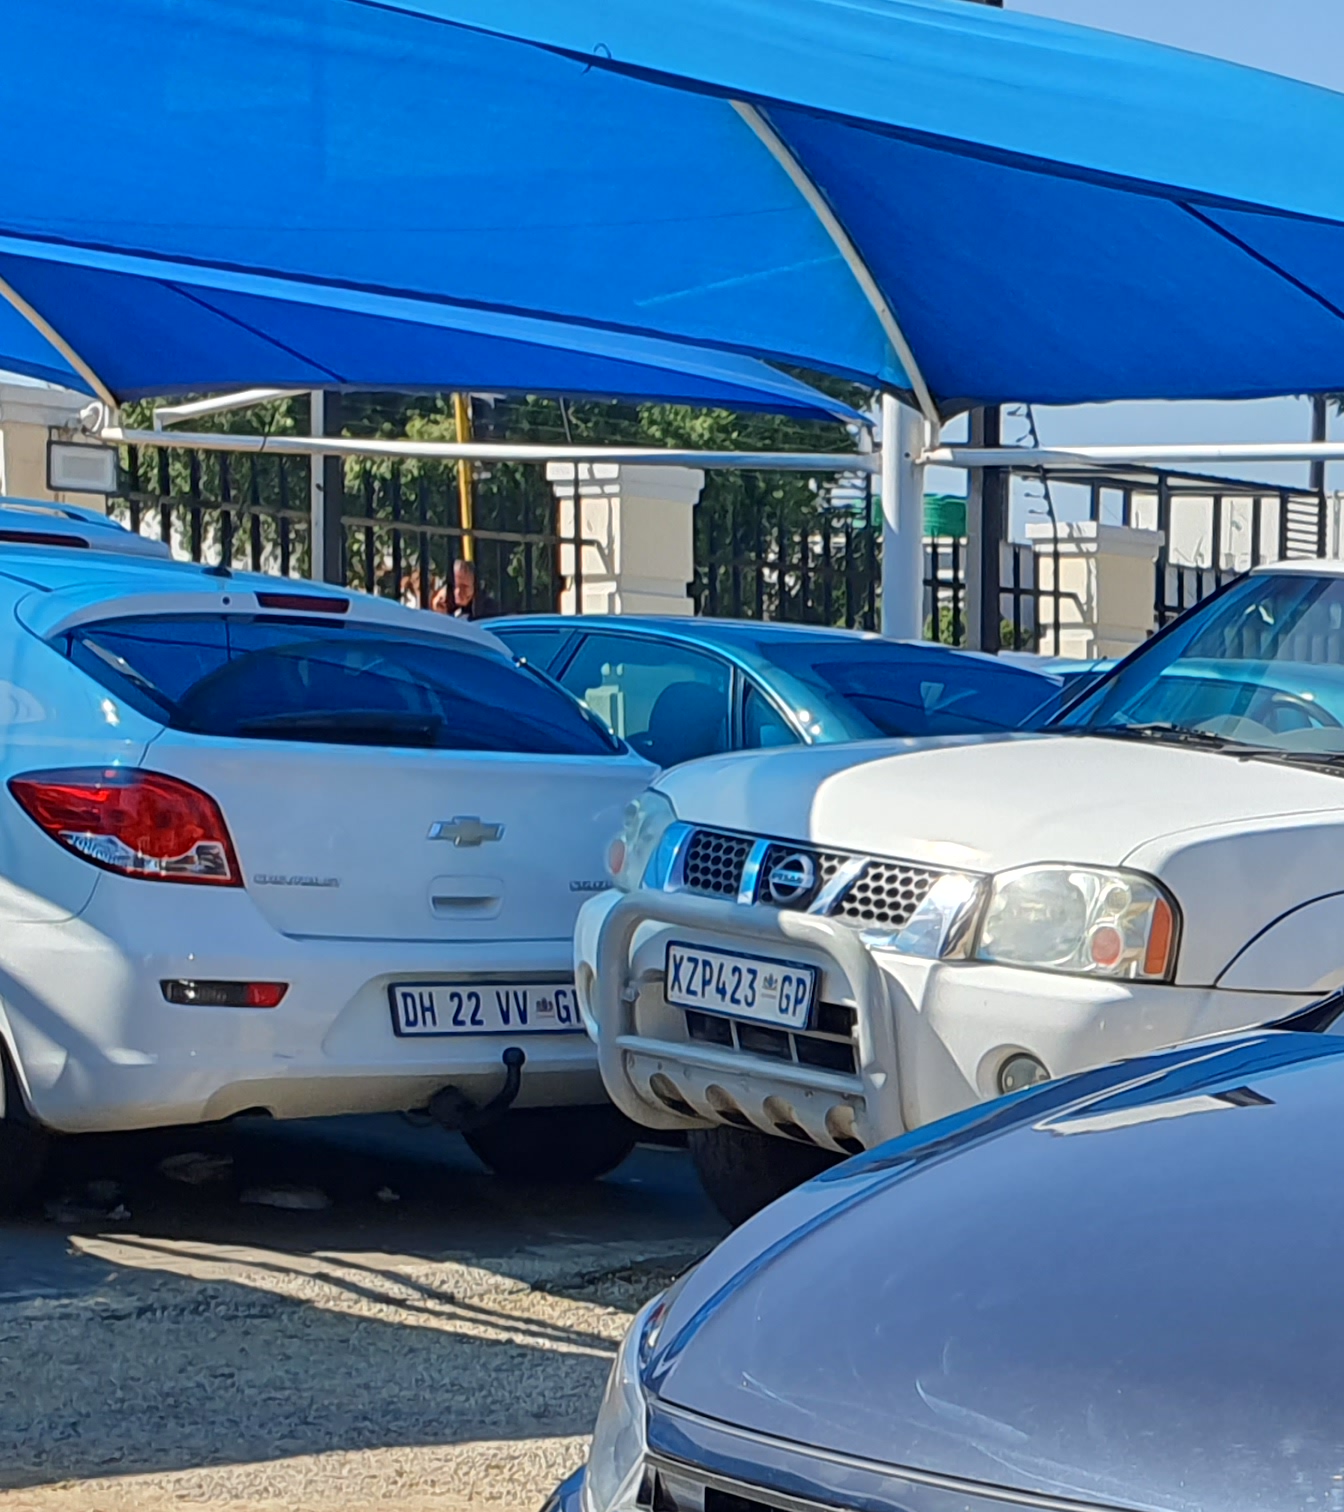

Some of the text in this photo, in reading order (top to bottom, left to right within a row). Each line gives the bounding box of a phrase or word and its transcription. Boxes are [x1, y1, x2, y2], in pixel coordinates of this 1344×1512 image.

[401, 991, 437, 1027] DH
[449, 990, 484, 1027] 22
[496, 989, 528, 1026] VV
[670, 953, 807, 1017] XZP423 GP
